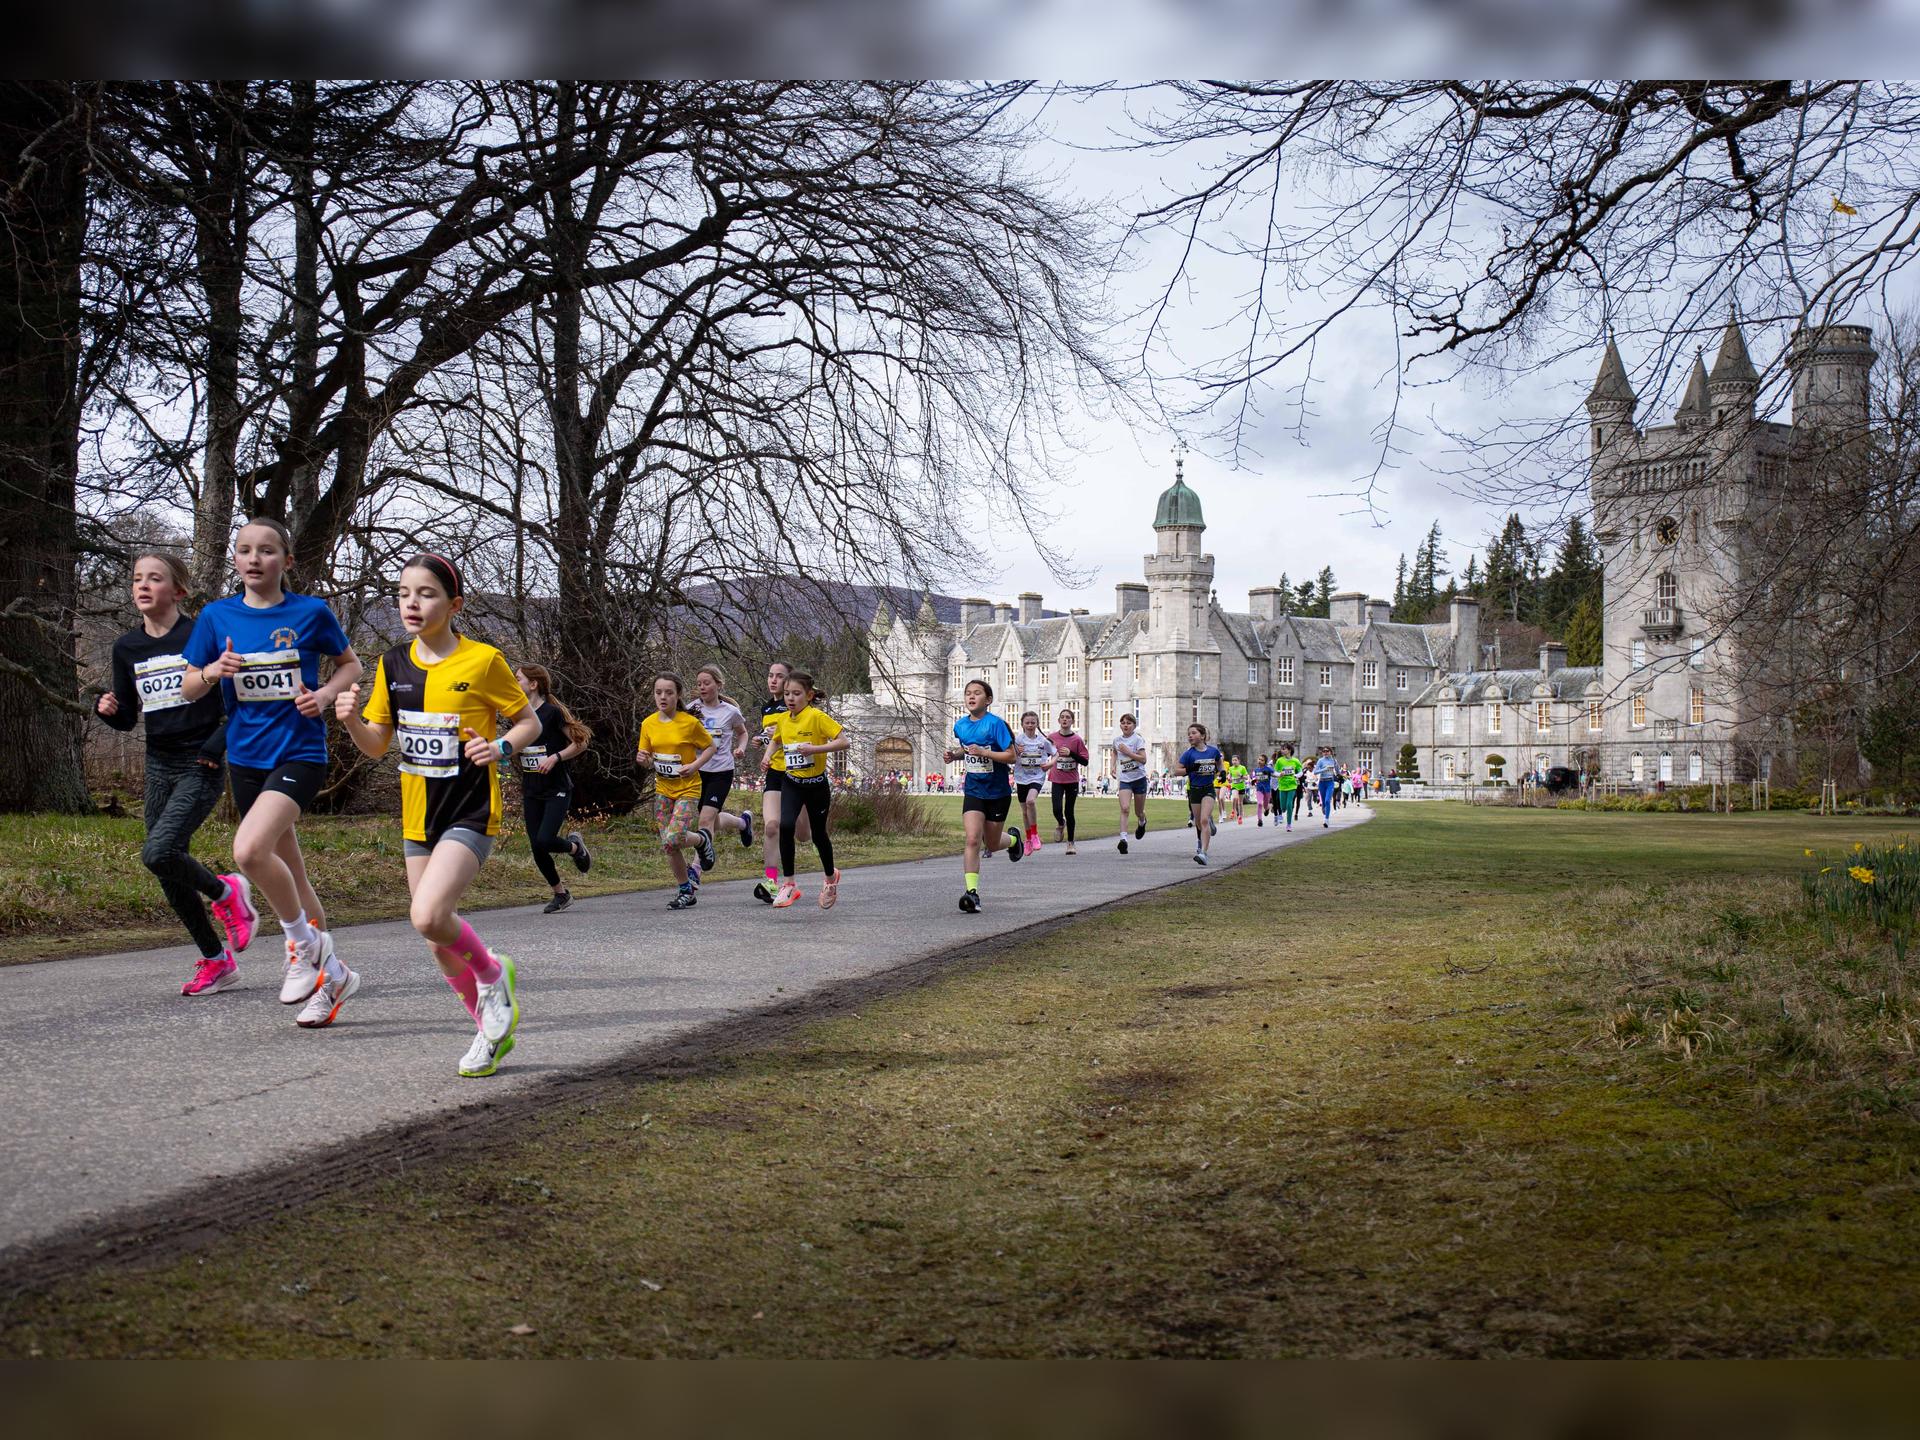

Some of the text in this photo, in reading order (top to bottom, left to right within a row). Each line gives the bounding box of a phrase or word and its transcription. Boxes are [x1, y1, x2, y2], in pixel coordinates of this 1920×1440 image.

[143, 674, 183, 694] 6022
[242, 672, 293, 690] 6041
[405, 736, 443, 755] 209
[526, 757, 539, 767] 121
[789, 755, 805, 765] 113
[966, 755, 990, 764] 6048
[659, 765, 673, 774] 110
[802, 776, 824, 784] PRO
